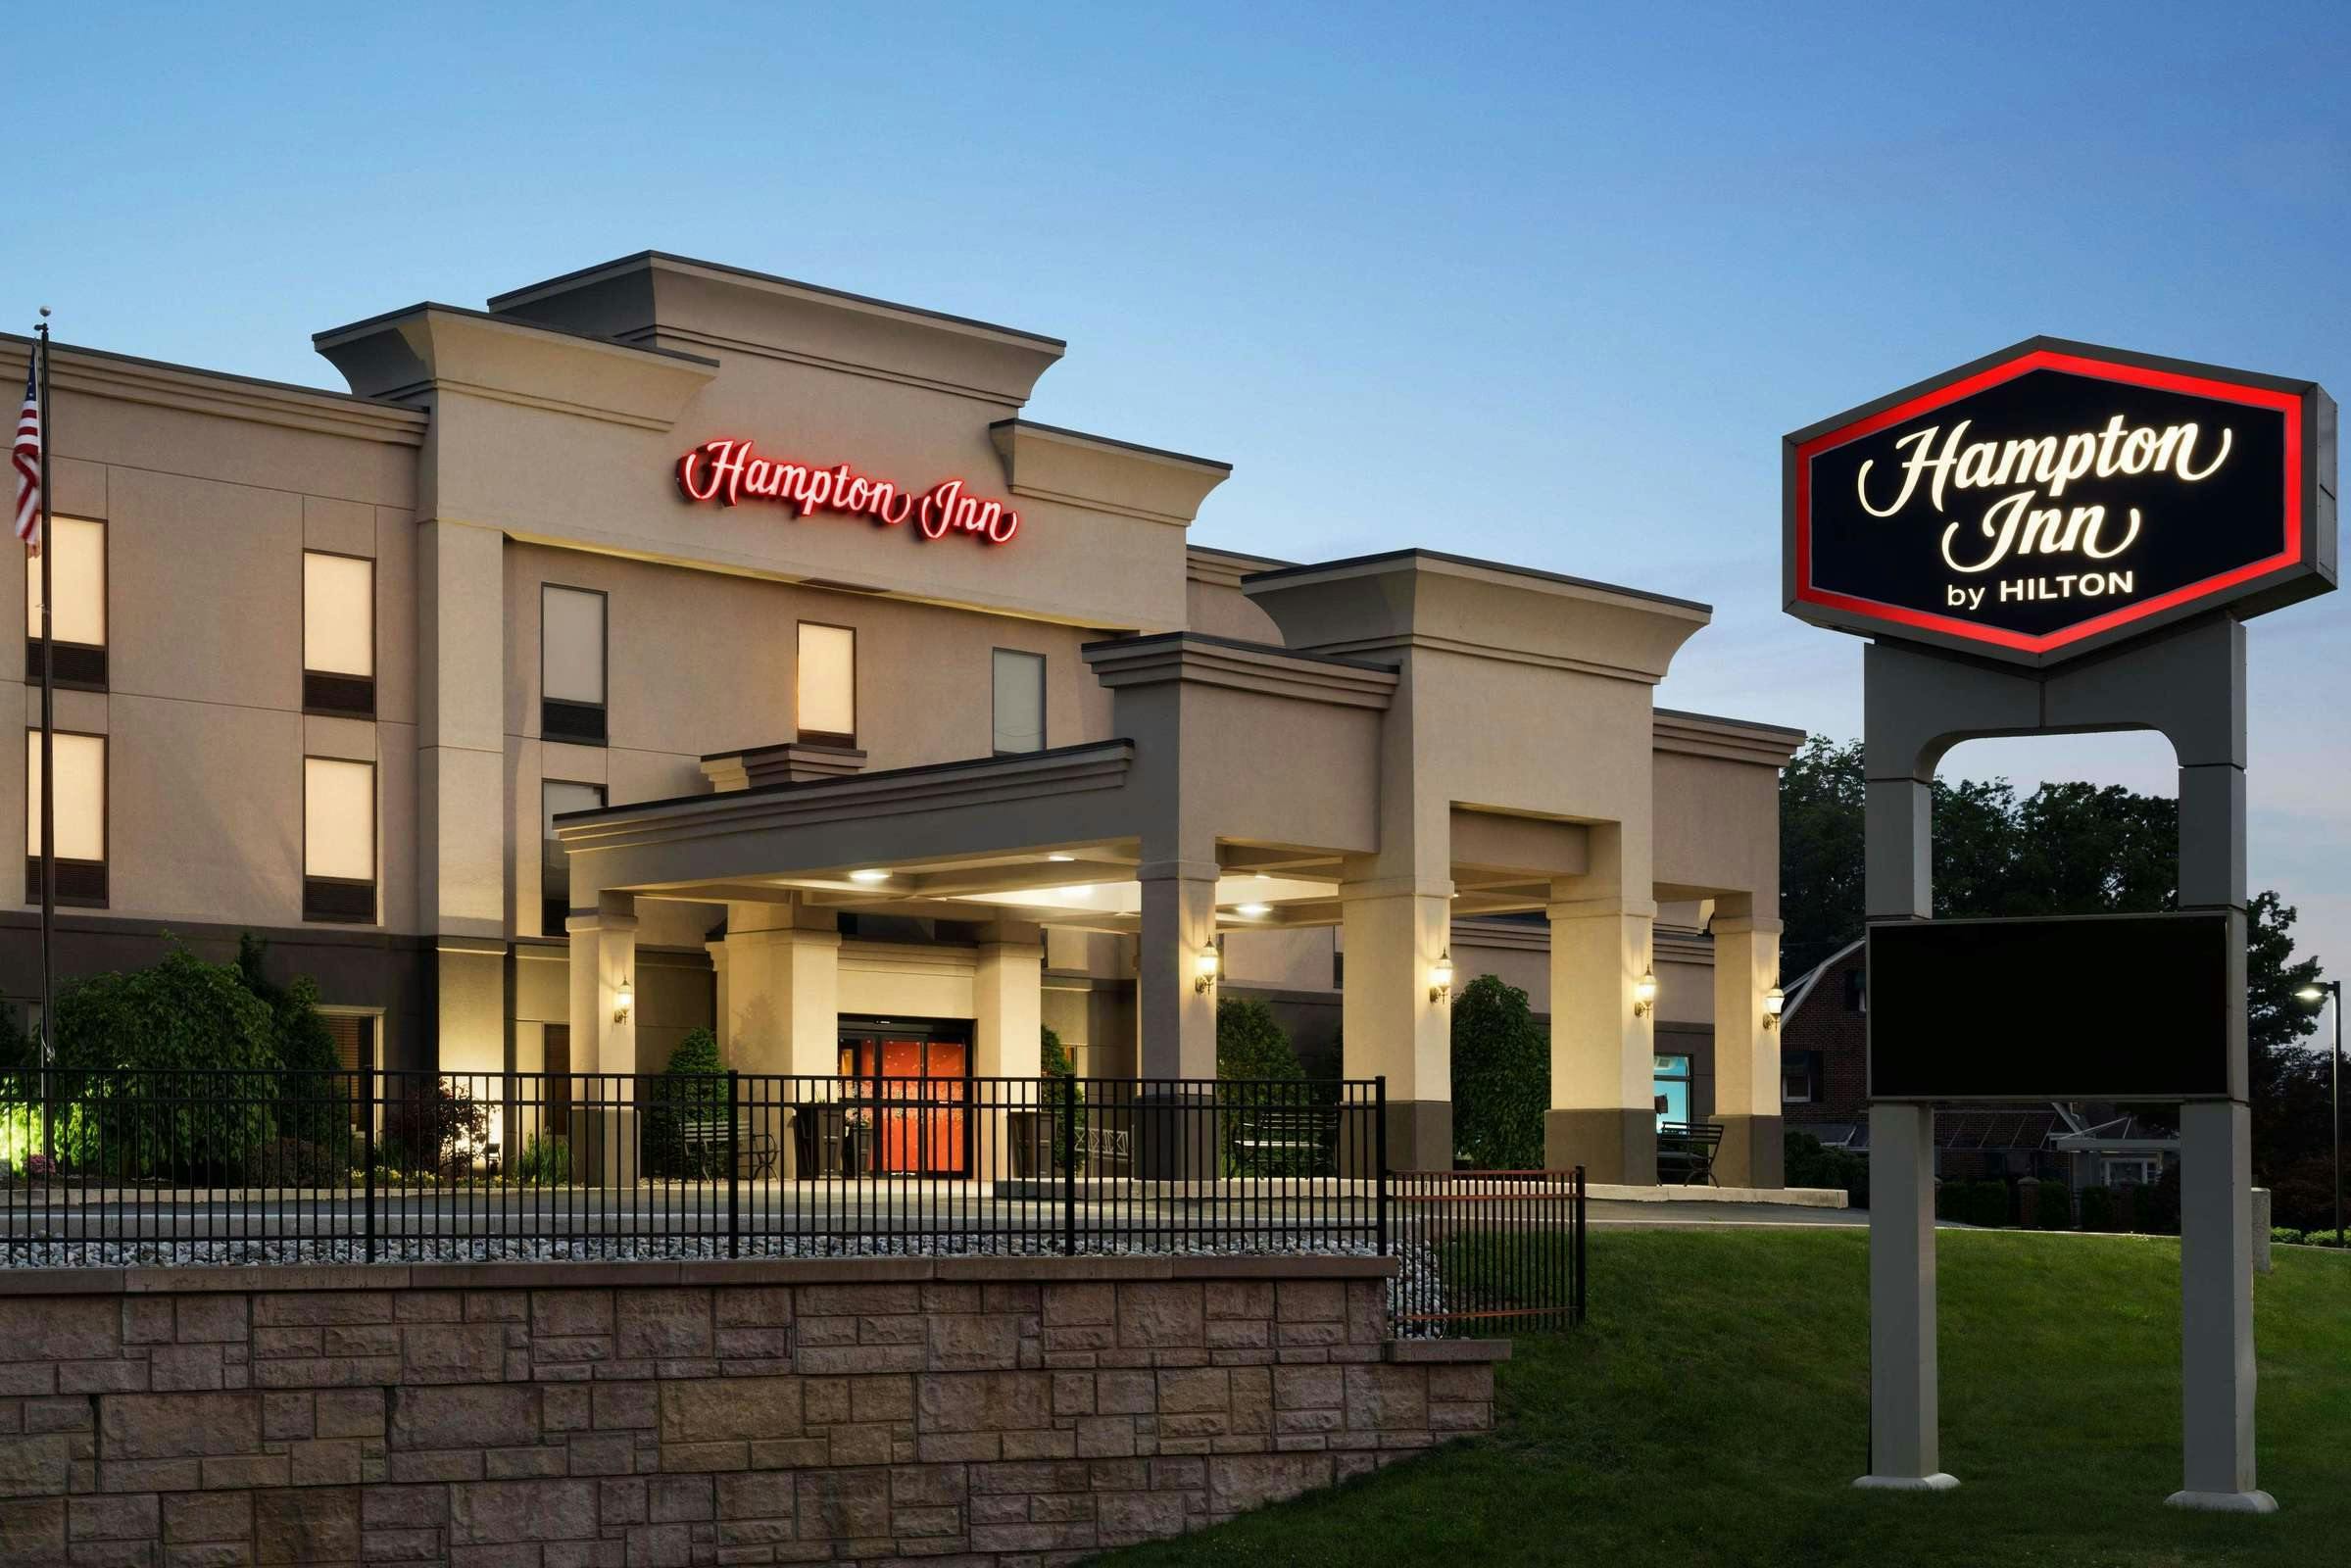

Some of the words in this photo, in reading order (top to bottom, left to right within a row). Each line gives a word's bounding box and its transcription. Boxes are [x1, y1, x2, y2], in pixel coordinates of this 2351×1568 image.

[682, 438, 912, 525] Hampton
[918, 479, 1019, 543] Inn
[1857, 415, 2232, 517] Hampton
[1941, 490, 2140, 572] Inn
[1946, 585, 1985, 611] by
[1999, 570, 2133, 602] HILTON
